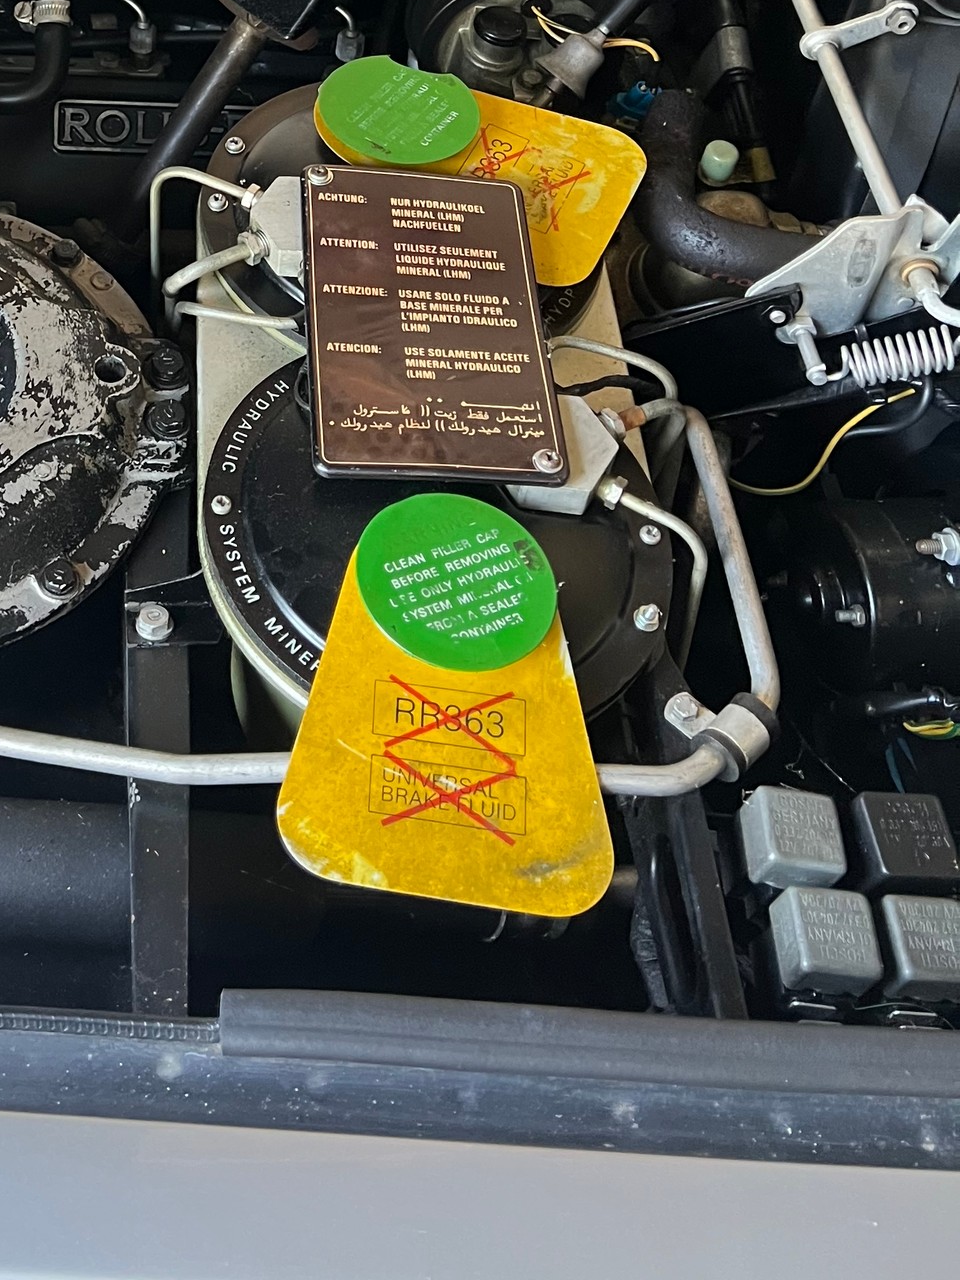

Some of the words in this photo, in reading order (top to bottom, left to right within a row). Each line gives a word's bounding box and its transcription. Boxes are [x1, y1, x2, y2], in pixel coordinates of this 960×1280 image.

[318, 192, 368, 205] ACHTUNG:
[390, 197, 411, 207] NUR
[413, 199, 485, 214] HYDRAULIKOEL
[392, 209, 436, 221] MINERAL
[438, 212, 465, 223] (LHM)
[393, 219, 461, 233] NACHFUELLEN
[320, 237, 379, 250] ATTENTION:
[394, 243, 437, 255] UTILISEZ
[439, 246, 498, 259] SEULEMENT
[396, 255, 435, 266] LIQUIDE
[436, 257, 506, 271] HYDRAULIQUE
[396, 266, 441, 278] MINERAL
[443, 269, 471, 281] (LHM)
[322, 284, 388, 297] ATTENZIONE:
[398, 289, 432, 300] USARE
[435, 291, 461, 302] SOLO
[464, 294, 500, 305] FLUIDO
[502, 296, 510, 306] A
[400, 301, 428, 311] BASE
[429, 302, 481, 315] MINERALE
[483, 306, 503, 316] PER
[401, 312, 460, 324] L'IMPIANTO
[463, 315, 518, 328] IDRAULICO
[401, 323, 431, 334] (LHM)
[326, 342, 382, 354] ATENCION:
[404, 346, 425, 357] USE
[428, 348, 491, 361] SOLAMENTE
[493, 352, 530, 363] ACEITE
[405, 358, 452, 370] MINERAL
[454, 361, 521, 374] HYDRAULICO
[406, 370, 436, 380] (LHM)
[221, 379, 290, 474] HYDRAULIC
[383, 553, 426, 574] CLEAN
[431, 539, 472, 559] FILLER
[476, 528, 500, 545] CAP
[219, 524, 261, 605] SYSTEM
[390, 566, 440, 590] BEFORE
[444, 543, 511, 573] REMOVING
[420, 579, 453, 599] ONLY
[395, 697, 505, 738] RR363
[382, 766, 499, 799] UNIVERSAL
[381, 785, 450, 811] BRAKE
[456, 796, 517, 821] FLUID
